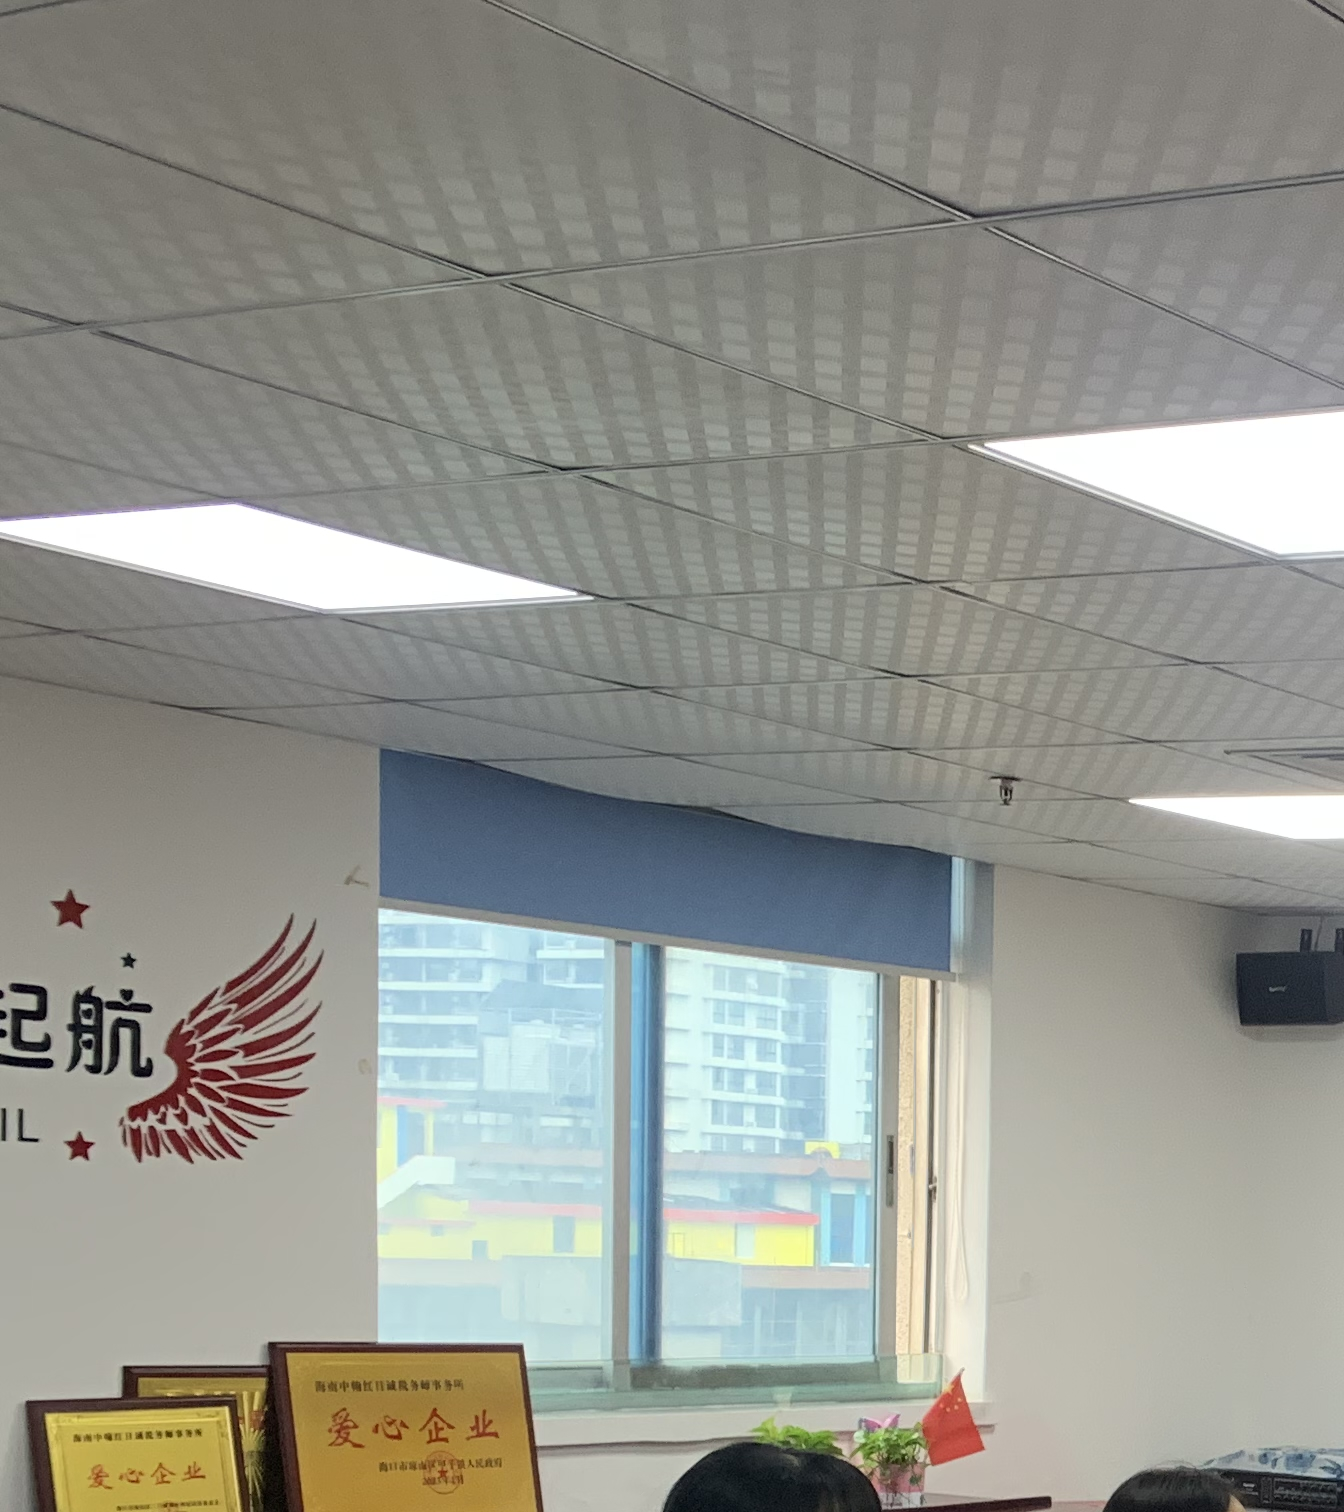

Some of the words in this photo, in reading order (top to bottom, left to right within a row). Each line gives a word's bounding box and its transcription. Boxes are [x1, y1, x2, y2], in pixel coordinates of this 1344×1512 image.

[328, 1407, 500, 1449] 爱心企业
[88, 1461, 206, 1490] 爱心企业
